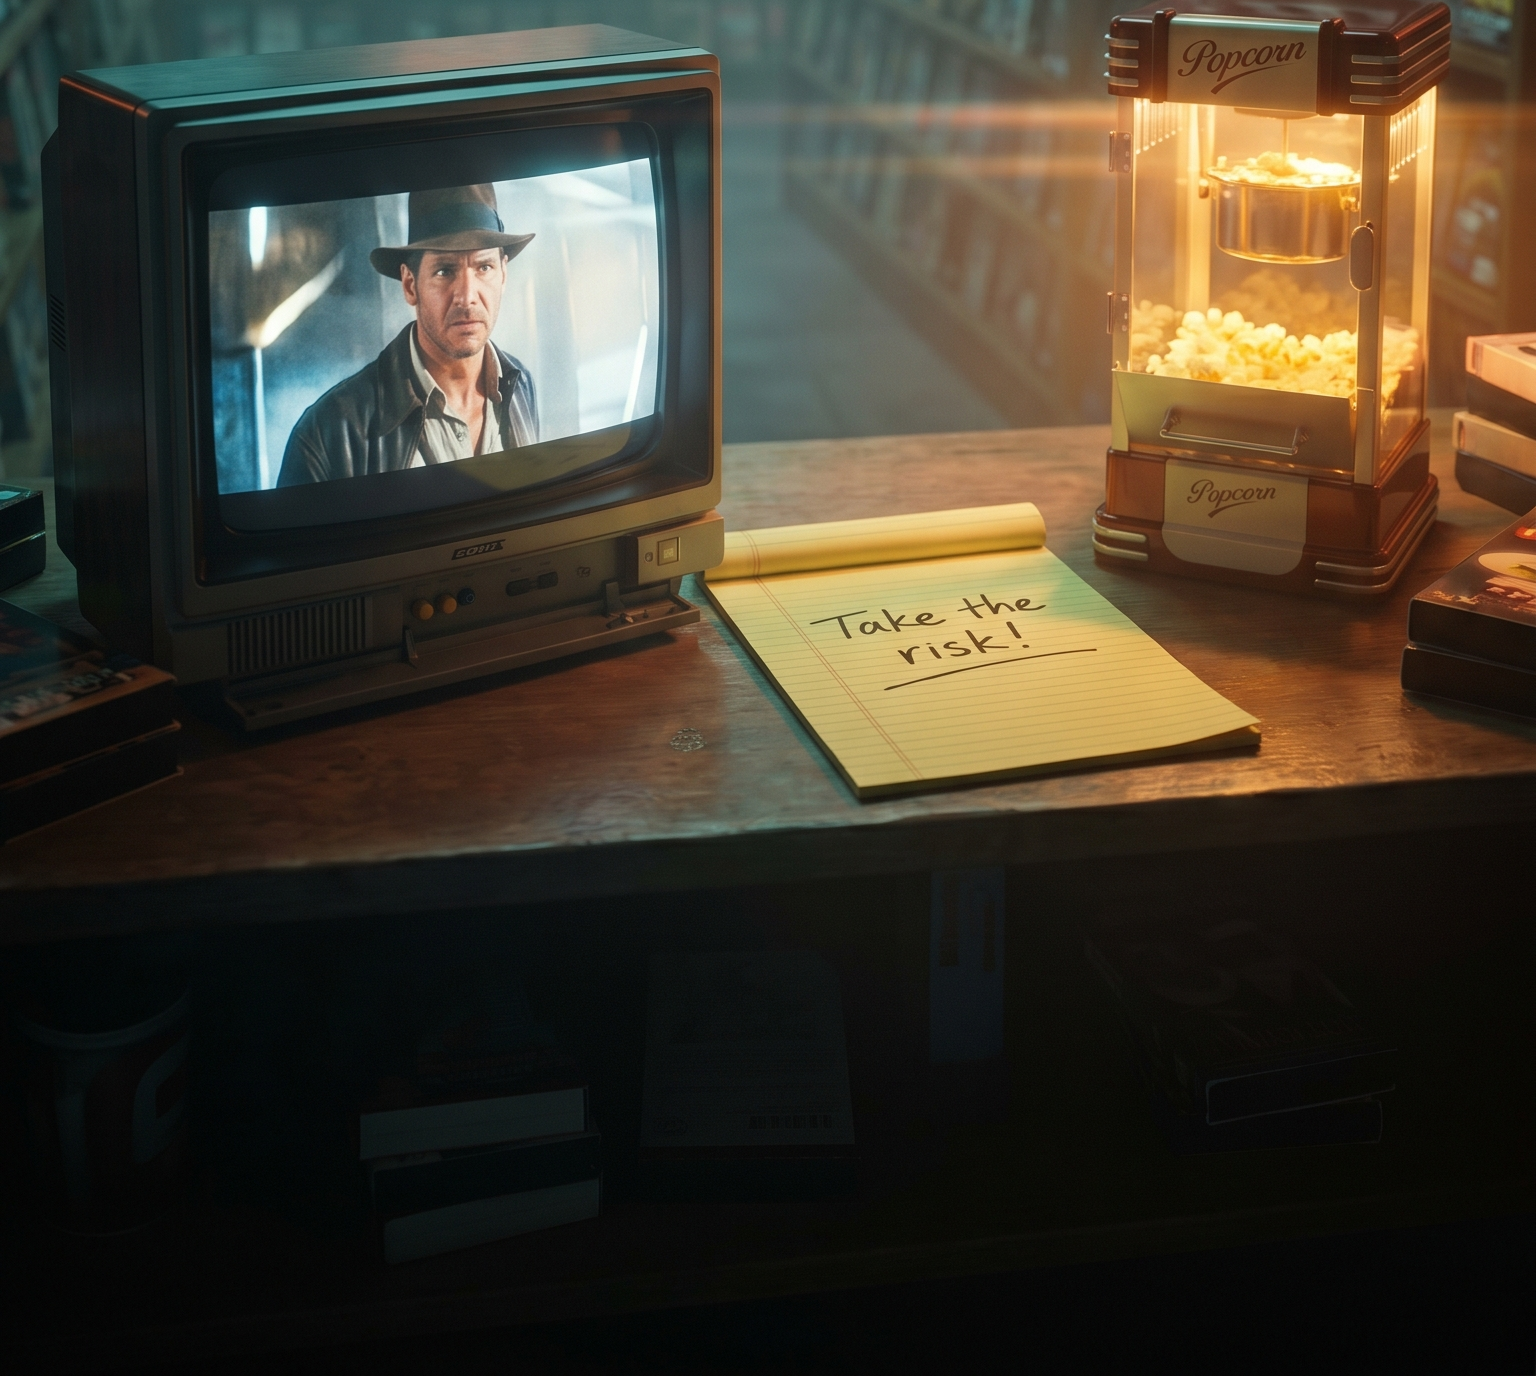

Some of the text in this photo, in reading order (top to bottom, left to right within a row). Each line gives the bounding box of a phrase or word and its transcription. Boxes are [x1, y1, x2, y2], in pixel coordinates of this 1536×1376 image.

[1177, 39, 1307, 82] Popcorn
[1187, 479, 1276, 510] Popcorn
[810, 594, 1046, 639] Take the
[897, 621, 1030, 664] risk!
